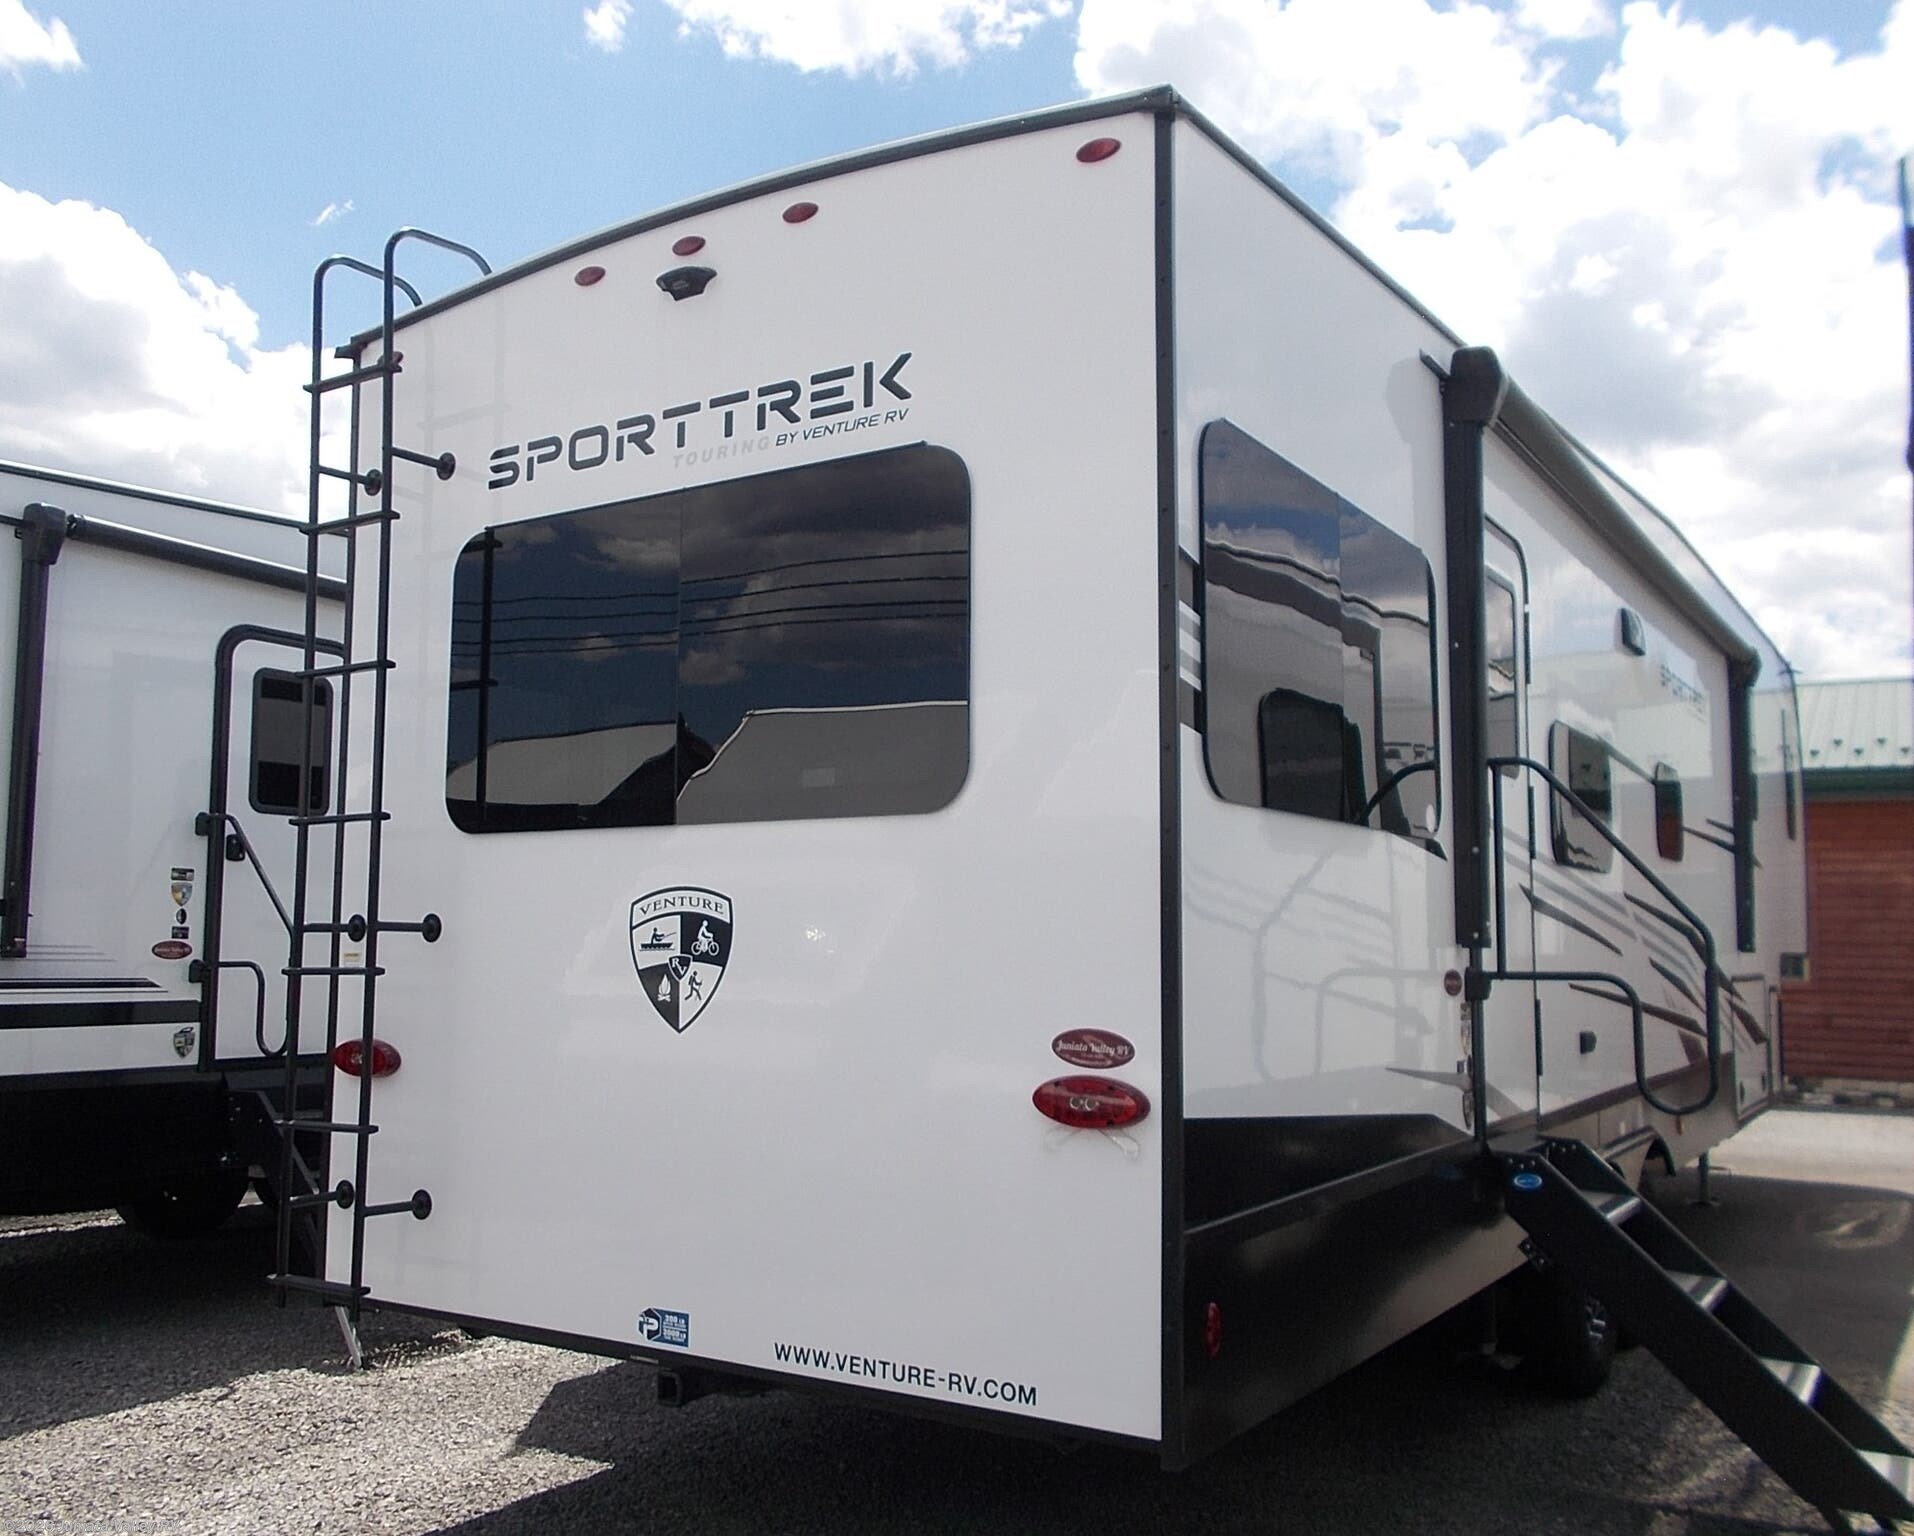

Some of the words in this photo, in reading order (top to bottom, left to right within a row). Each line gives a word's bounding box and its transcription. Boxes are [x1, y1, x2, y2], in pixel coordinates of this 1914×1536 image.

[488, 352, 912, 490] SPORTTREK
[672, 435, 770, 469] TOURING
[775, 431, 800, 447] BY
[803, 413, 881, 441] VENTURE
[884, 407, 910, 425] RV
[639, 896, 725, 915] VENTURE
[774, 1342, 1038, 1406] WWW.VENTURE-RV.COM
